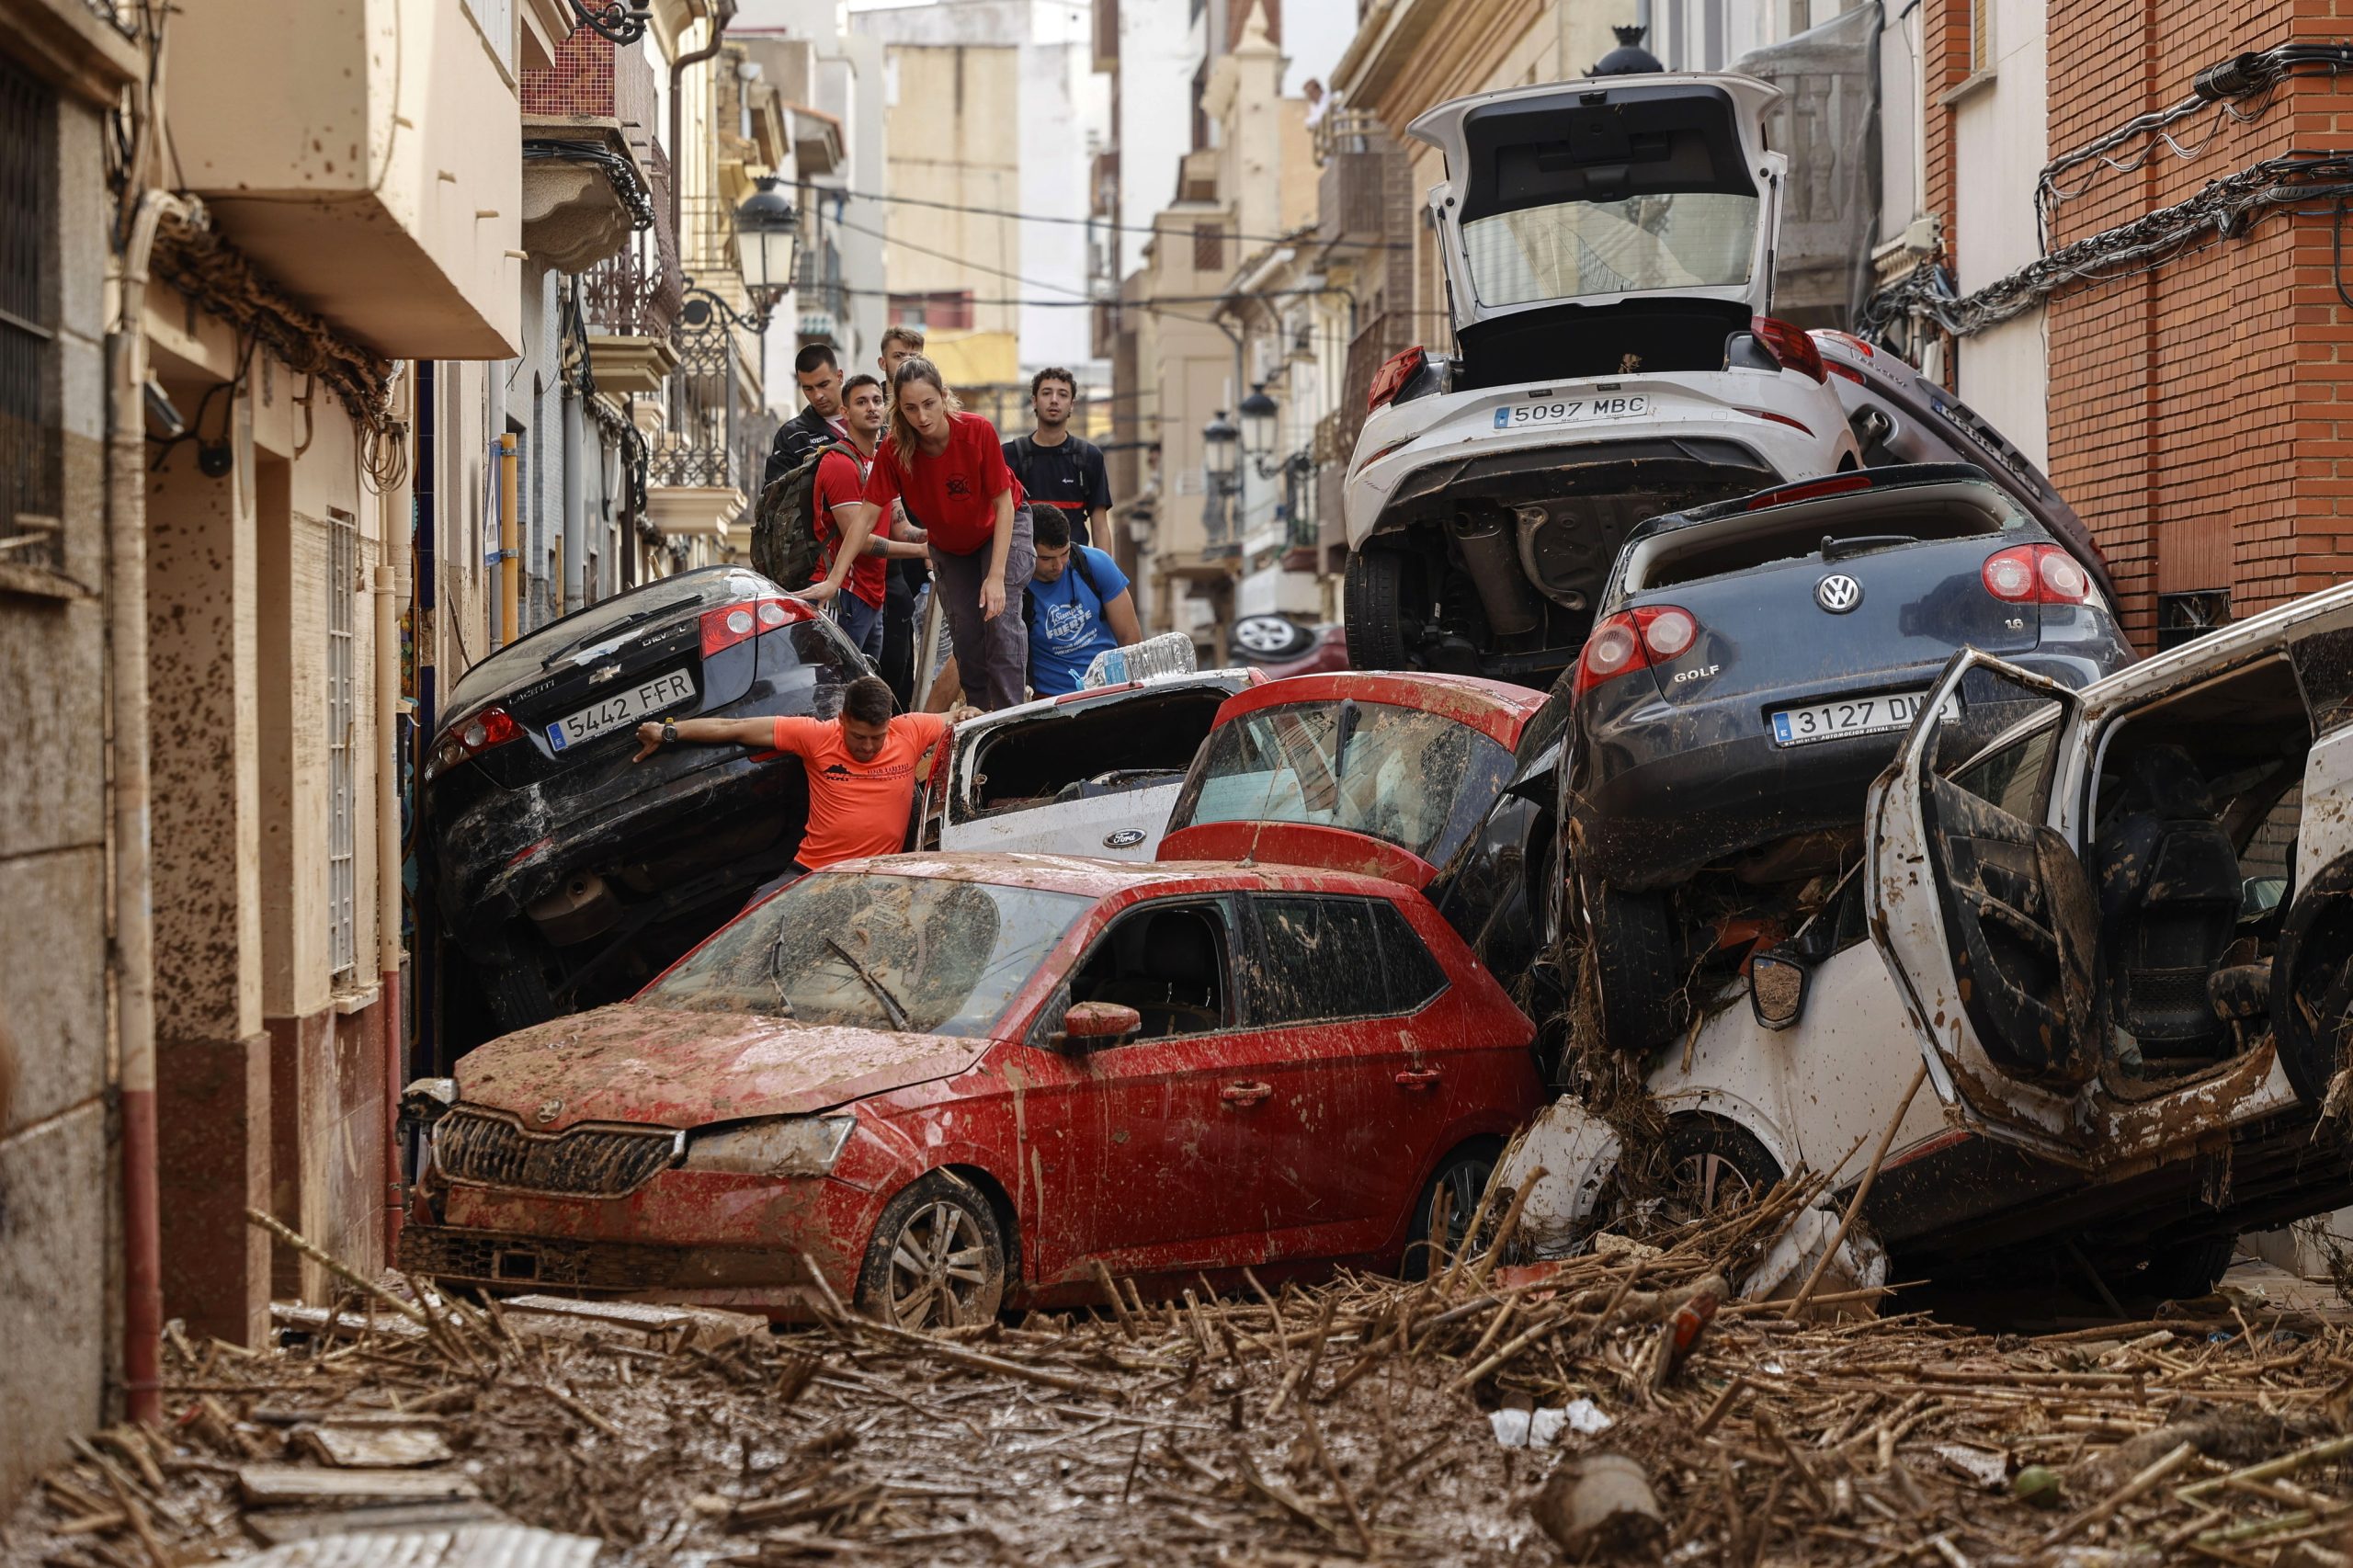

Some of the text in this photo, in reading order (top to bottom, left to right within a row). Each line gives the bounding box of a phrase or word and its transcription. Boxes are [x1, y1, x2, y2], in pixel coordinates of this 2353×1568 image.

[1515, 402, 1583, 422] 5097
[1593, 397, 1644, 415] MBC
[1046, 609, 1092, 639] FUERTE
[1674, 665, 1720, 683] GOLF
[567, 699, 631, 738] 5442
[639, 675, 688, 709] FFR
[1798, 701, 1875, 733] 3127
[1821, 729, 1864, 741] AUTOMOCION
[1866, 726, 1889, 734] JESVAL
[1113, 832, 1136, 844] Ford
